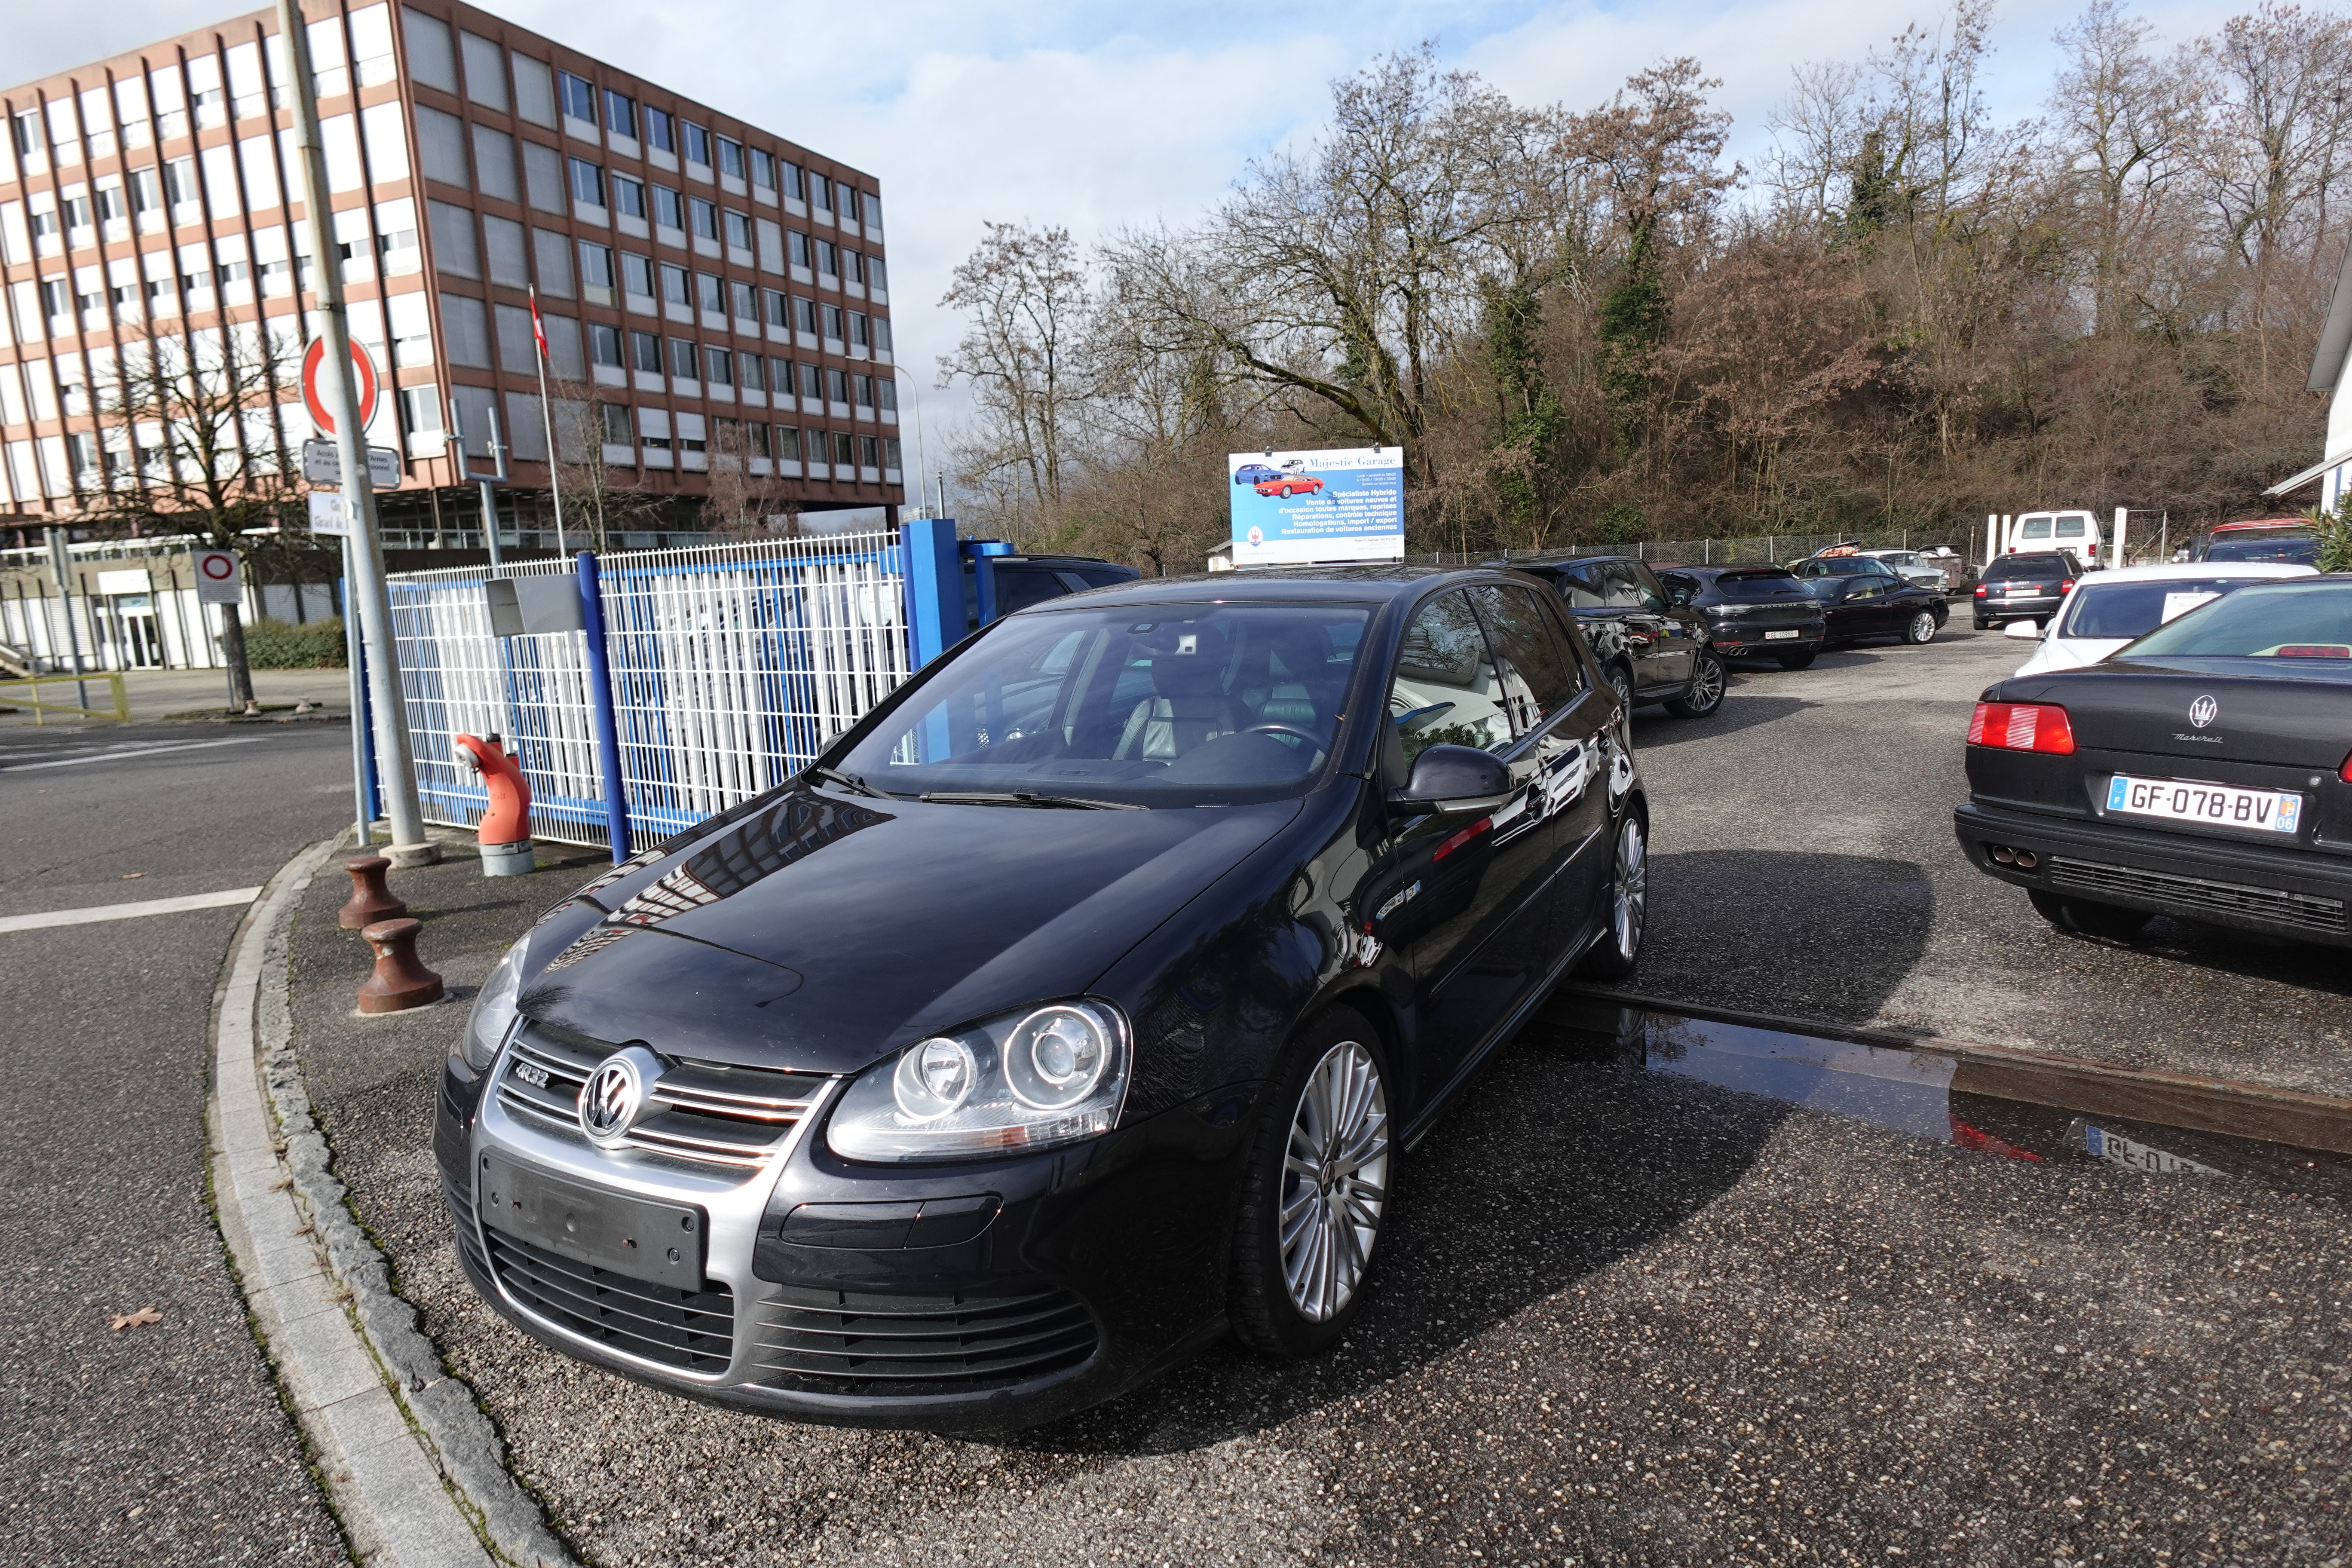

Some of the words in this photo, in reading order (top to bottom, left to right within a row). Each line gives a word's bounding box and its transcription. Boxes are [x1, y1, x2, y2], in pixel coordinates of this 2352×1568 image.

[1309, 458, 1353, 469] Majestic
[1357, 456, 1396, 467] Garage
[1333, 490, 1369, 499] Spécialiste
[1371, 489, 1396, 498] Hybride
[1292, 513, 1334, 521] Réparations,
[1364, 510, 1397, 518] technique
[1293, 519, 1346, 527] Homologations,
[2171, 733, 2223, 743] Maserati
[2131, 784, 2272, 823] GF-078-BV
[2276, 817, 2293, 830] 06
[517, 1063, 549, 1088] R32
